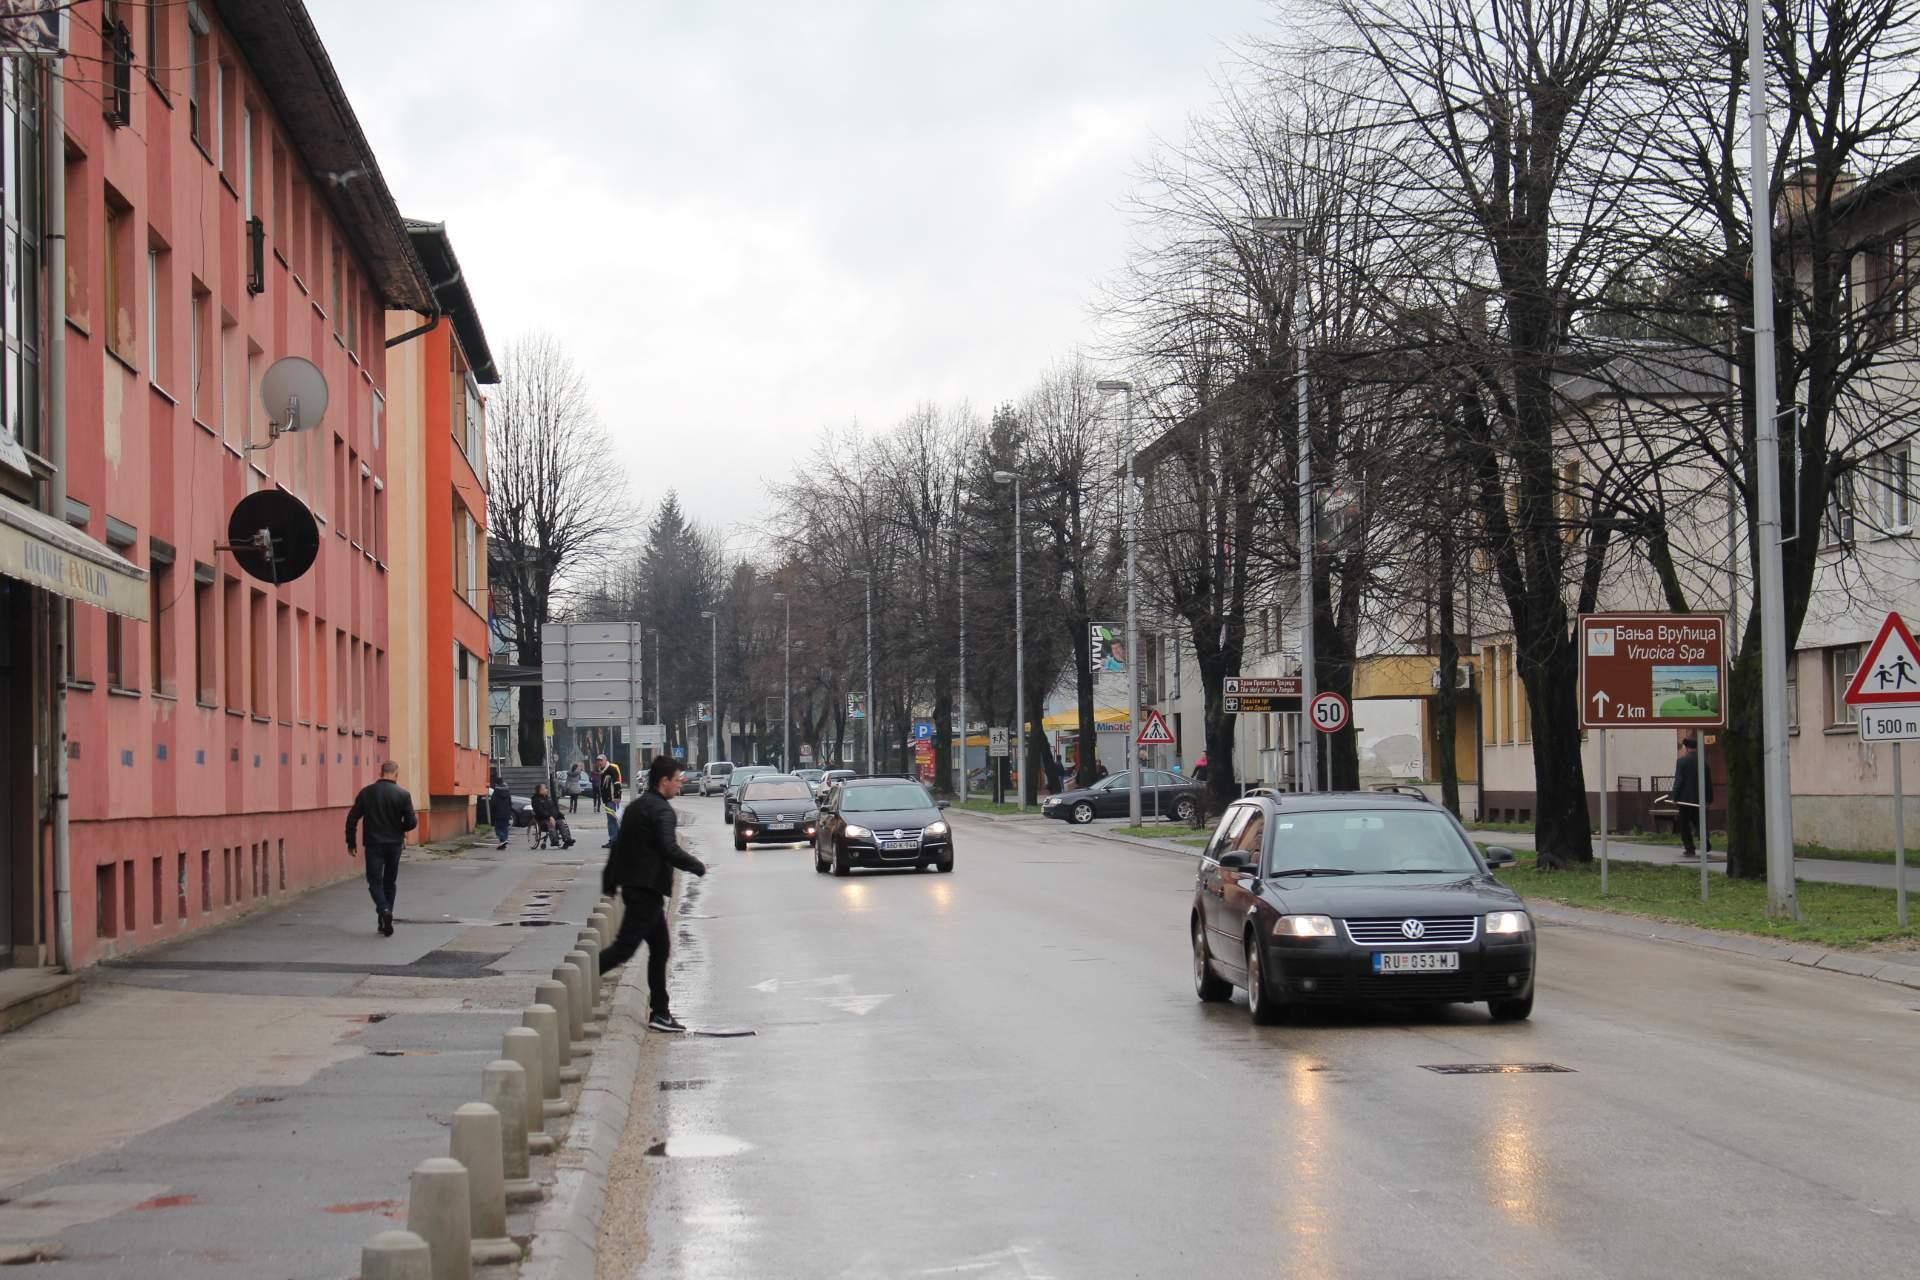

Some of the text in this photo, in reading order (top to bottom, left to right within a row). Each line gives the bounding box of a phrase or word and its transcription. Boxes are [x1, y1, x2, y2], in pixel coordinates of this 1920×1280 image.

[1615, 625, 1716, 644] Бања Врућица
[1627, 644, 1705, 663] Vrucica Spa
[1317, 703, 1341, 722] 50
[1616, 703, 1645, 718] 2 km
[919, 726, 928, 737] P
[1878, 719, 1917, 734] 500 m
[1384, 955, 1400, 969] RU
